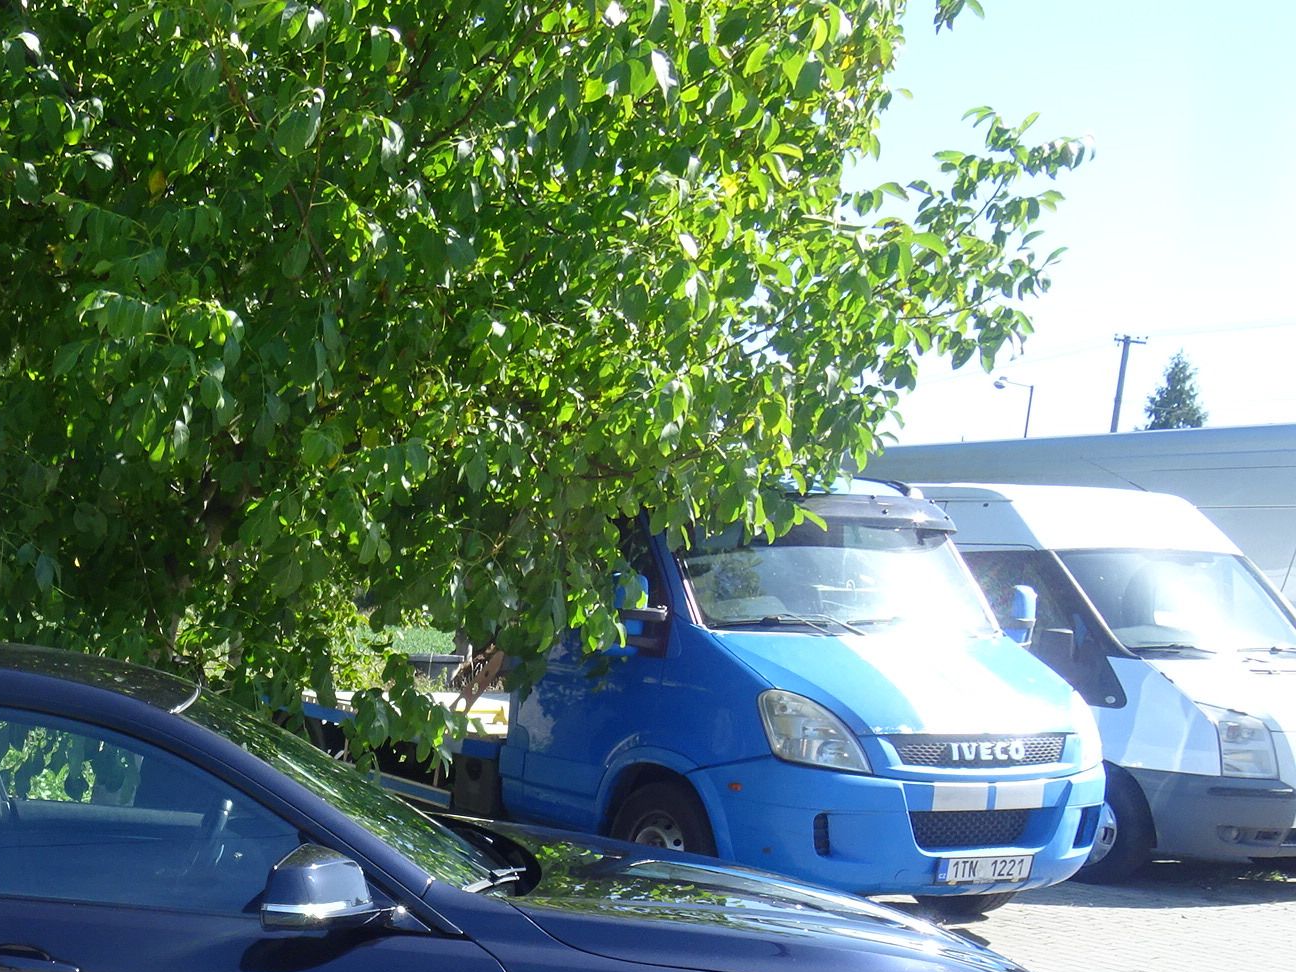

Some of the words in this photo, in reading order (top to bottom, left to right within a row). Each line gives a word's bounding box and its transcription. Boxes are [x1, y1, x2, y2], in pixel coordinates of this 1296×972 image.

[950, 741, 1025, 761] IVECO
[952, 860, 979, 878] 1TN
[991, 858, 1025, 877] 1221
